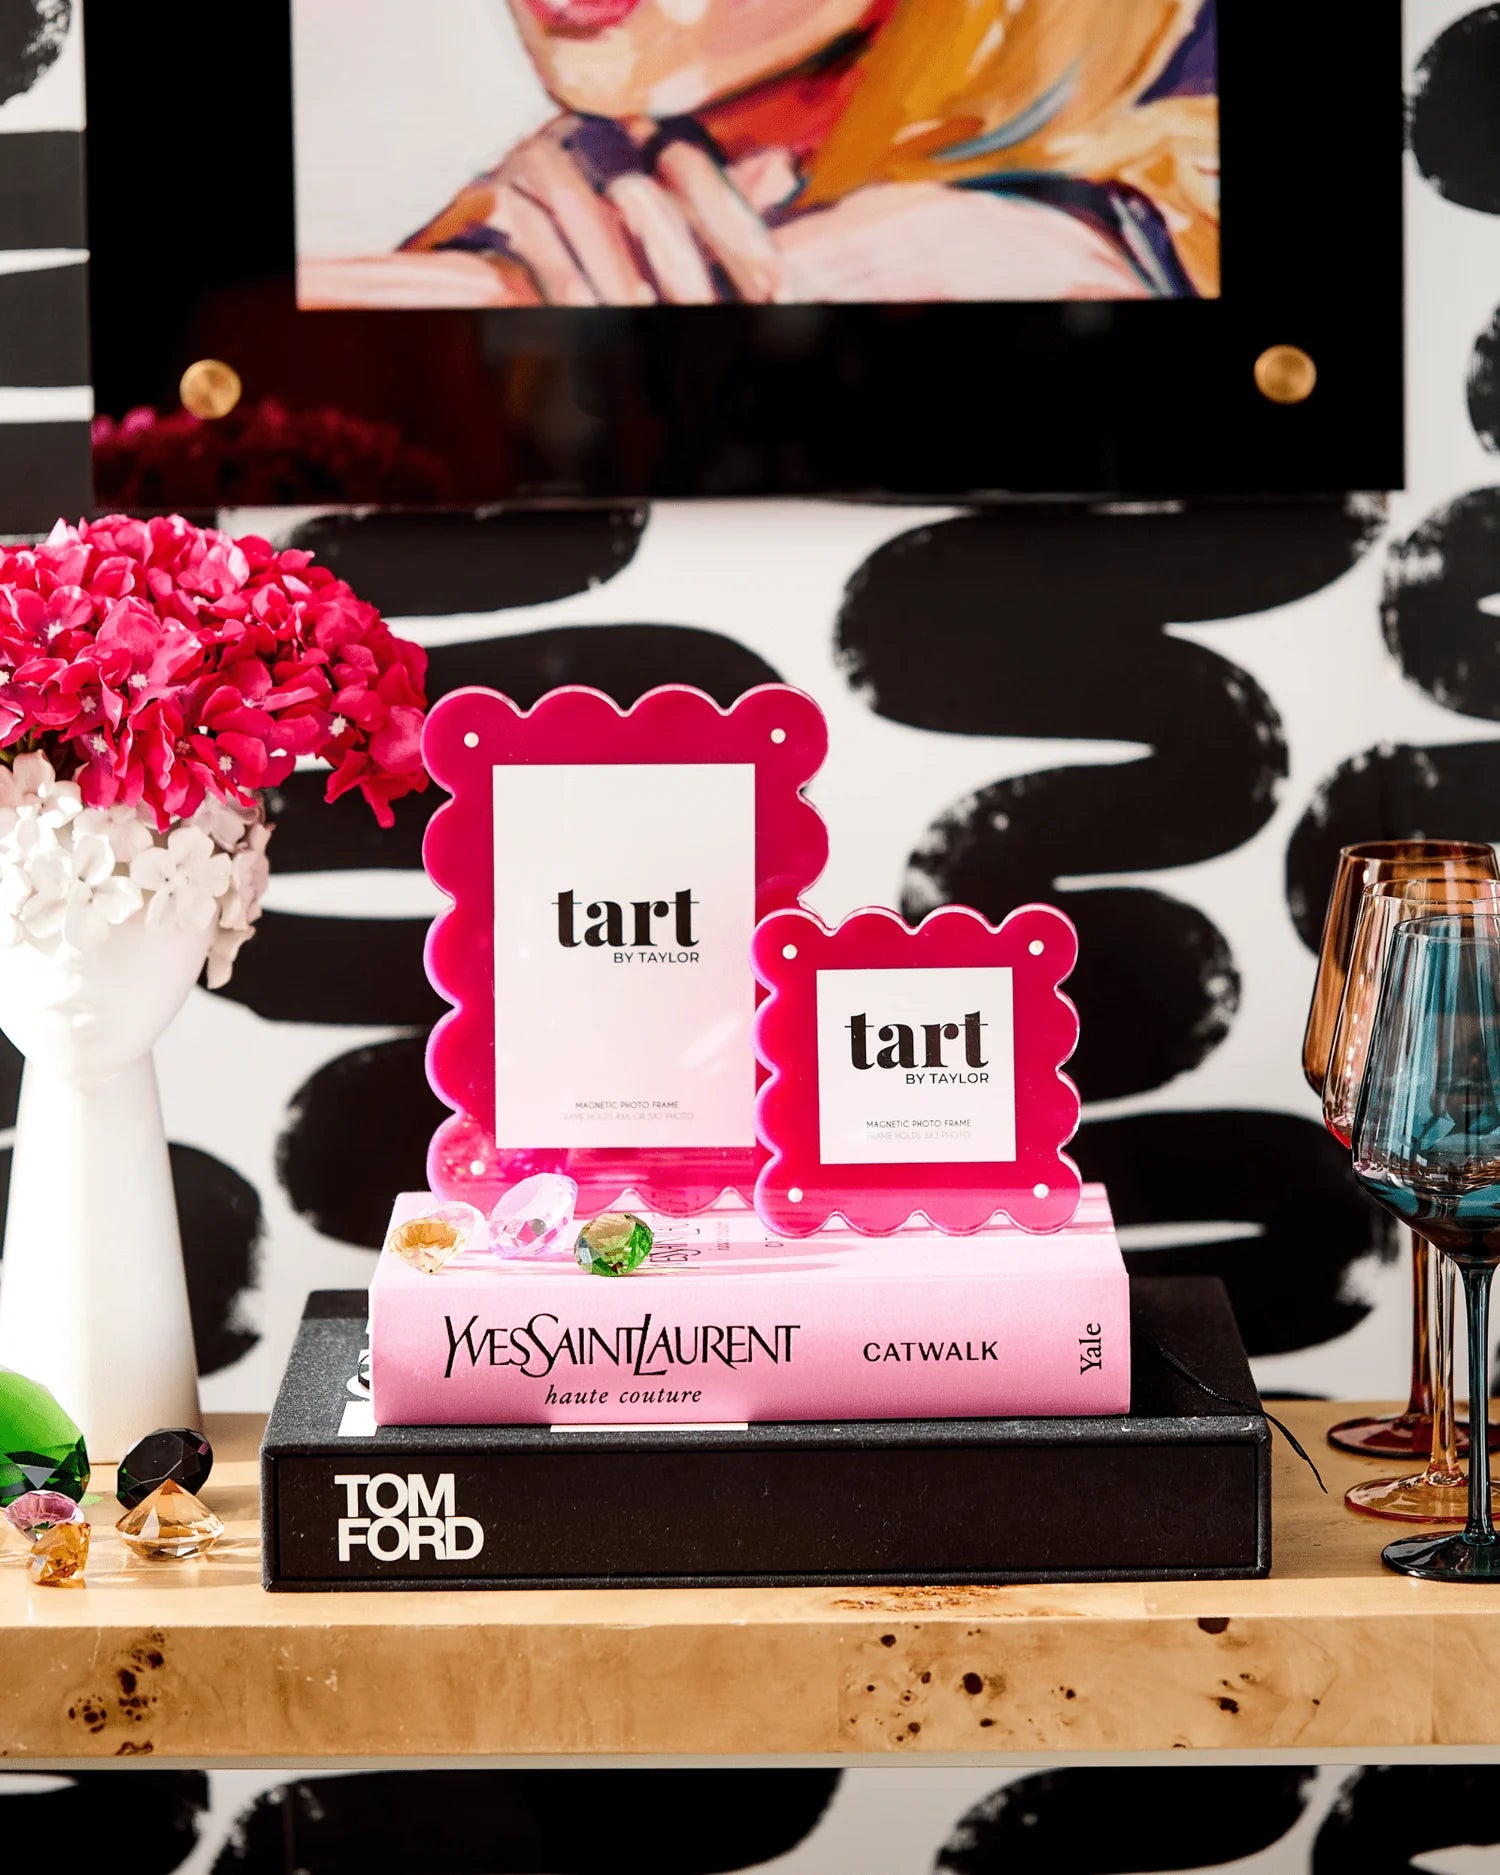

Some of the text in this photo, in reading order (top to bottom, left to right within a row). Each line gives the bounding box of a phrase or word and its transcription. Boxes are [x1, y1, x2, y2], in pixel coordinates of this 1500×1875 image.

[551, 888, 700, 948] tart
[613, 951, 700, 964] BY TAYLOR
[844, 1011, 989, 1070] tart
[906, 1072, 989, 1085] BY TAYLOR
[575, 1101, 679, 1109] MAGNETIC PHOTO FRAME
[866, 1119, 972, 1129] MAGNETIC PHOTO FRAME
[863, 1341, 999, 1362] CATWALK
[1078, 1322, 1102, 1375] Yale
[544, 1384, 702, 1406] haute couture
[334, 1473, 456, 1518] TOM
[338, 1516, 485, 1562] FORD
